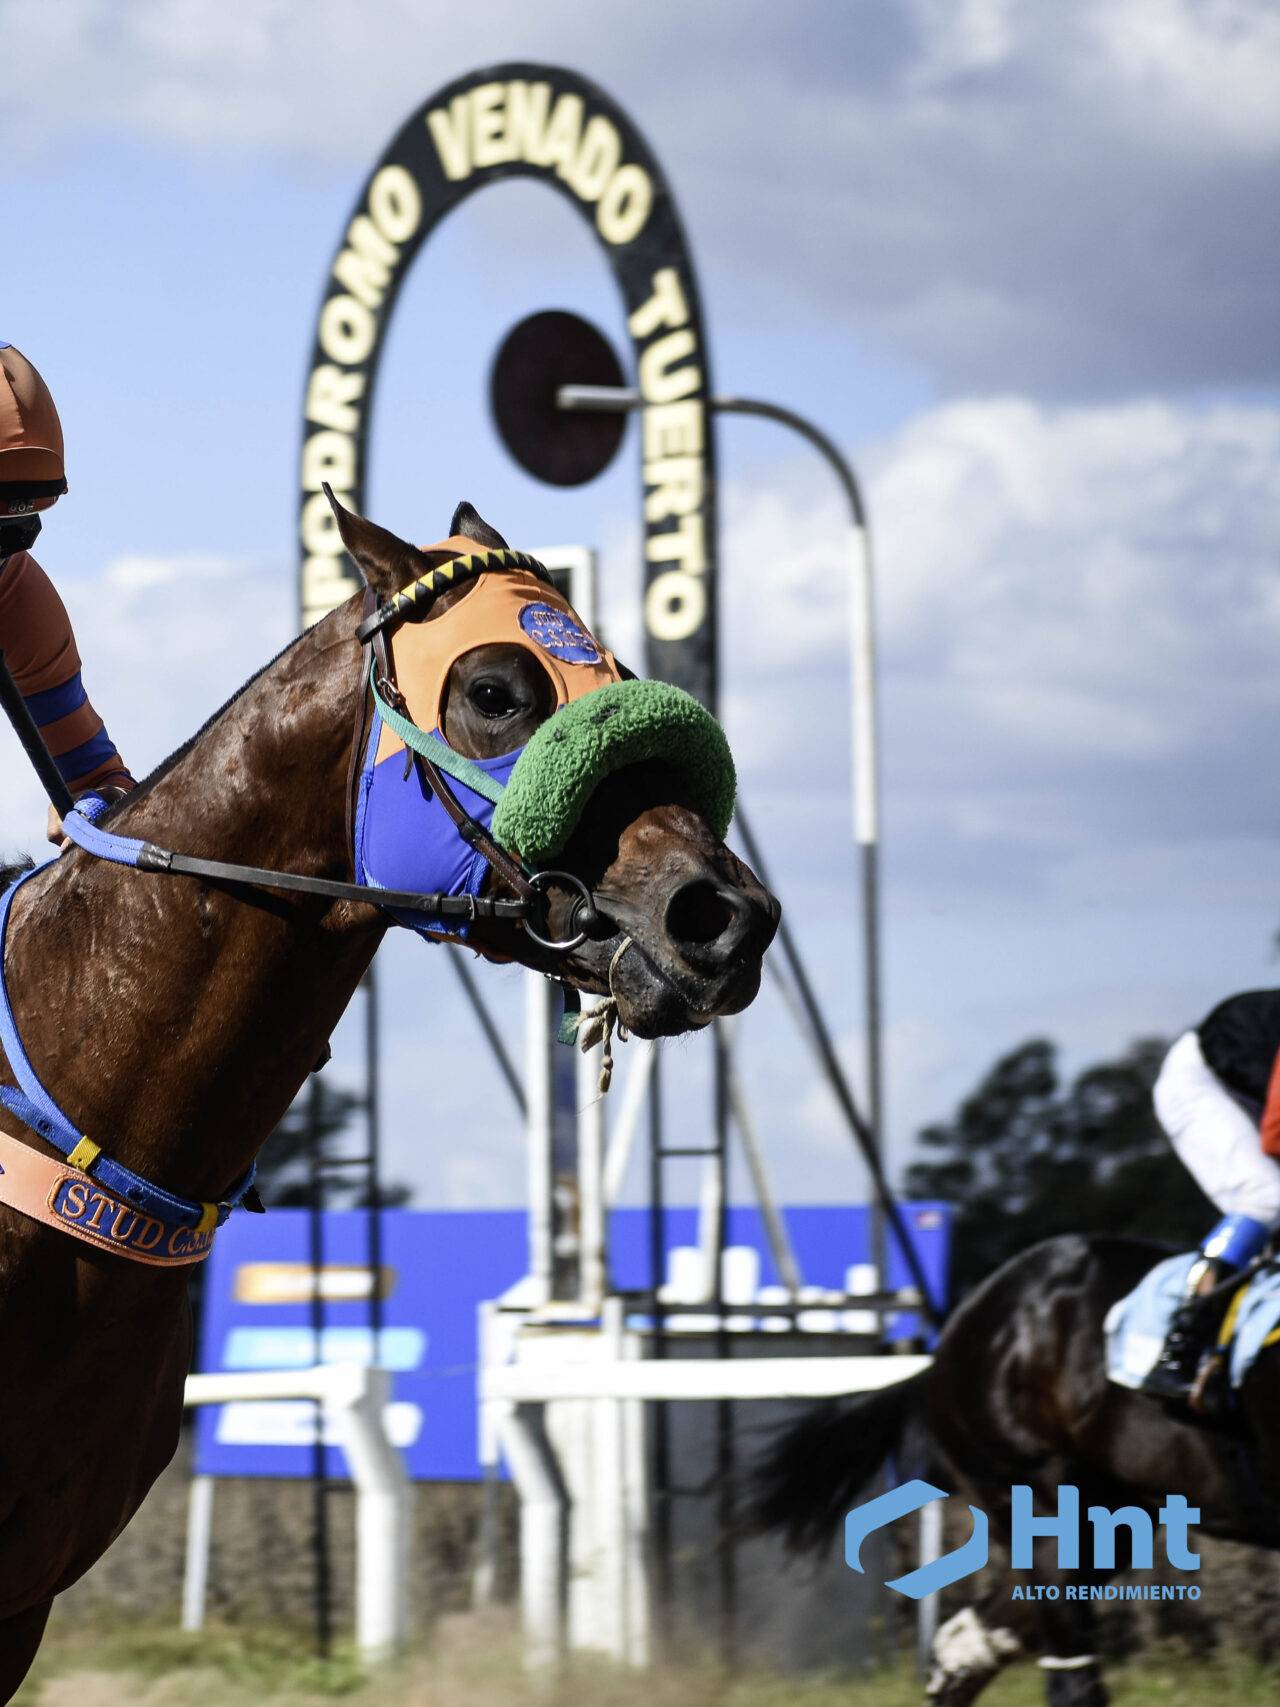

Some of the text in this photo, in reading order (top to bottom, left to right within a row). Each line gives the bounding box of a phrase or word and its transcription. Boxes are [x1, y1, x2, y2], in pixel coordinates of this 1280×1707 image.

[427, 80, 653, 245] VENADO
[628, 267, 707, 642] TUERTO
[60, 1183, 165, 1249] STUD
